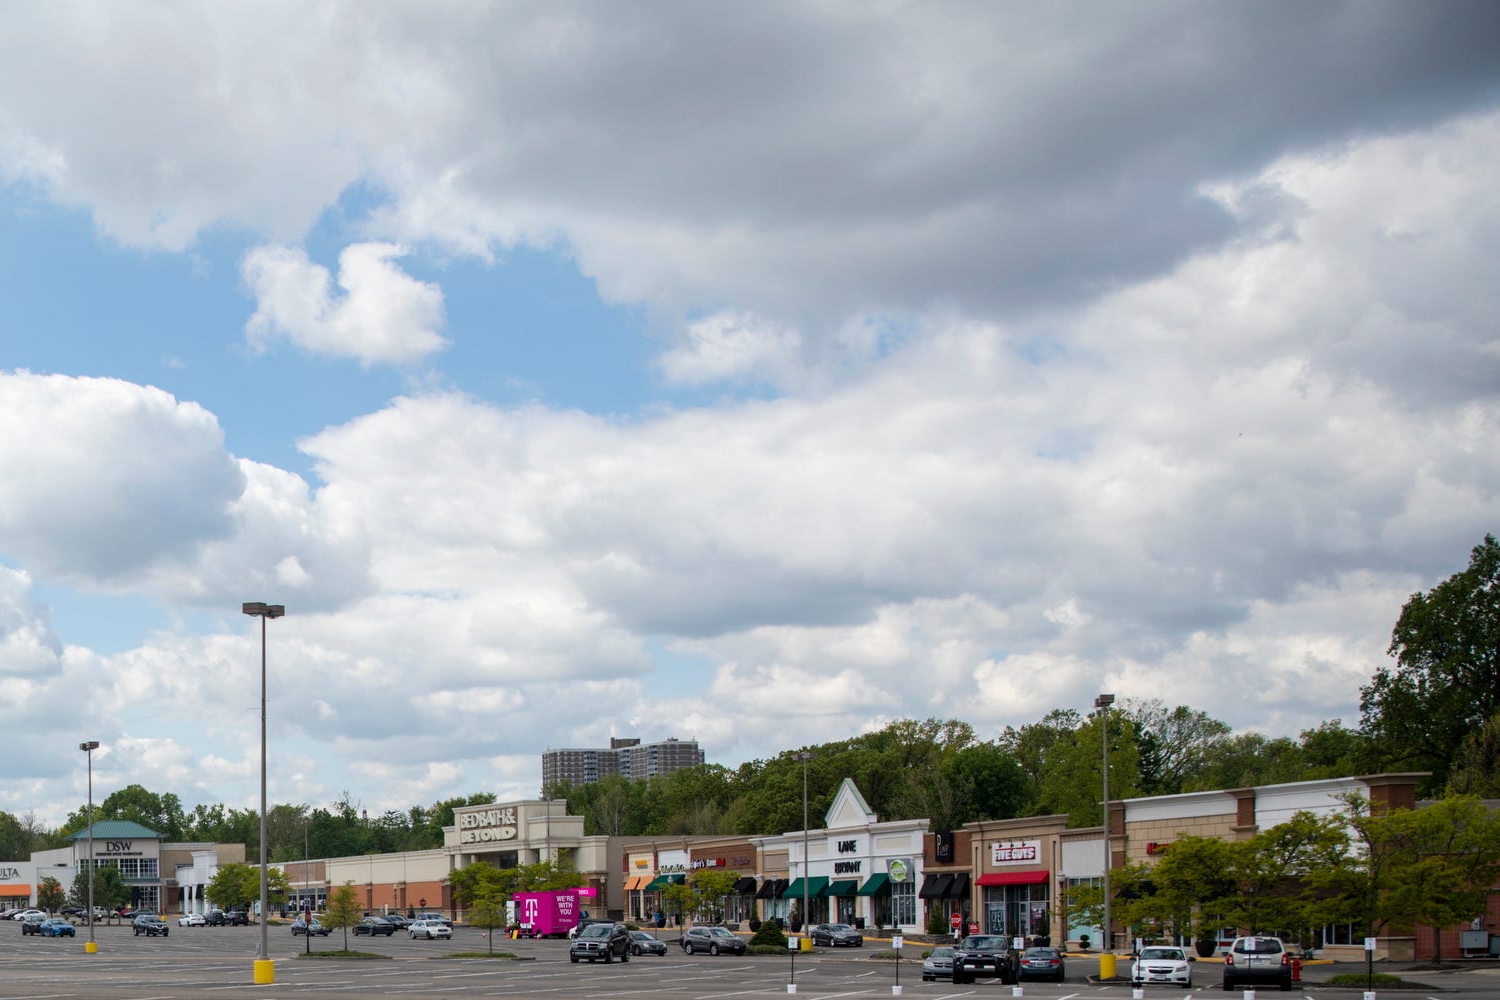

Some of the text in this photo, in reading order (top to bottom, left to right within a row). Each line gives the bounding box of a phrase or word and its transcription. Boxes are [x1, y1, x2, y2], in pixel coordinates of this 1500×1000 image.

[460, 808, 516, 829] BED BATH &
[461, 827, 516, 844] BEYOND
[106, 841, 132, 851] DSW
[838, 840, 856, 853] LANE
[996, 848, 1034, 860] FIVE GUYS
[834, 861, 861, 874] BRYANT
